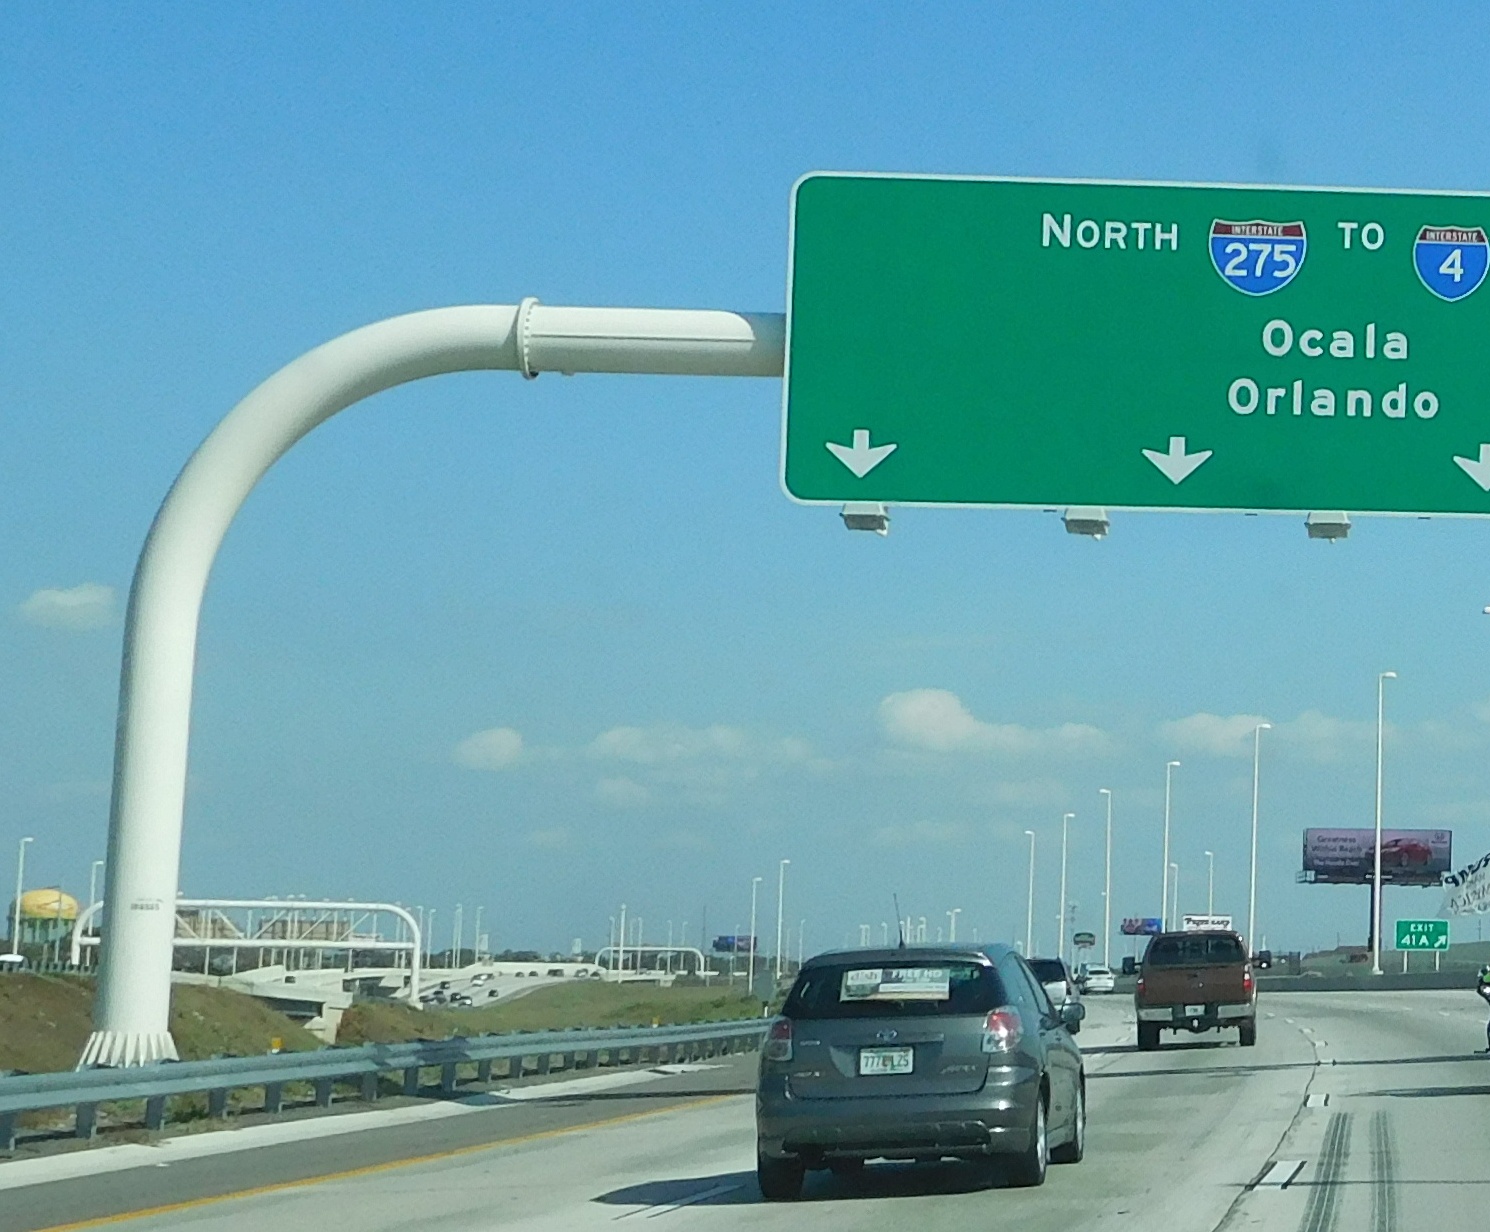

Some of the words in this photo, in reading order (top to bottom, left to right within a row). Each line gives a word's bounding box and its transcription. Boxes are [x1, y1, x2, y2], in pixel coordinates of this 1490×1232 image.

[1042, 213, 1178, 251] NORTH
[1231, 225, 1284, 236] INTERSTATE
[1337, 222, 1384, 250] TO
[1426, 230, 1478, 243] INTERSTATE
[1224, 242, 1297, 278] 275
[1438, 248, 1464, 283] 4
[1262, 319, 1408, 360] Ocala
[1228, 377, 1439, 419] Orlando
[1410, 923, 1434, 932] EXIT
